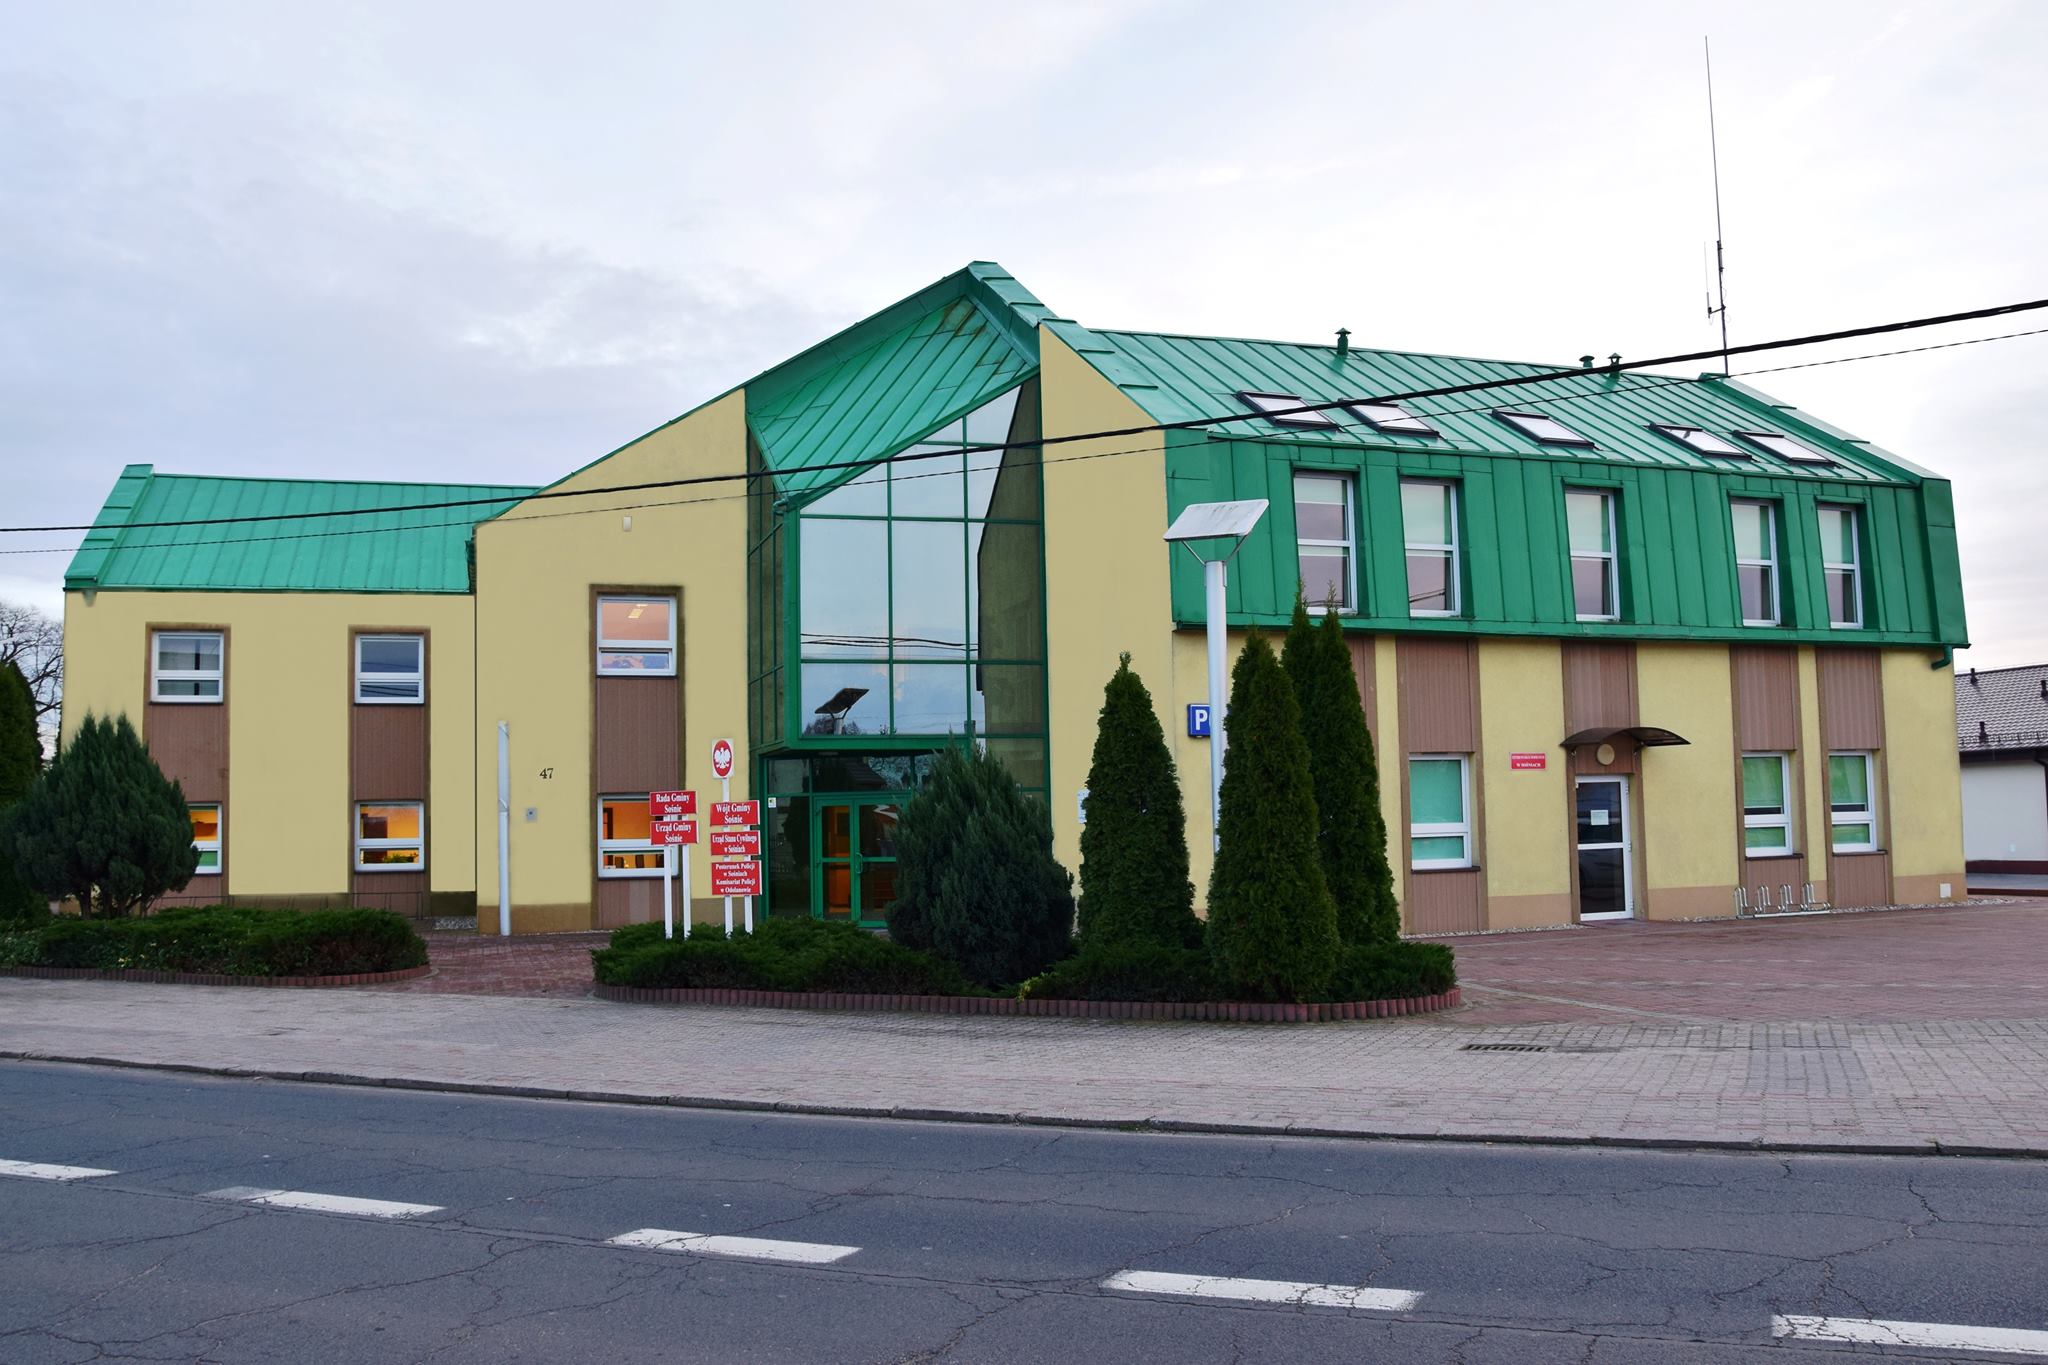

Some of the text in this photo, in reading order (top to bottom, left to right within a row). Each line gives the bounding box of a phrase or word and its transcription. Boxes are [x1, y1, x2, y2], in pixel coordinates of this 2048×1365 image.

[1195, 709, 1208, 730] P
[539, 767, 554, 779] 47
[656, 792, 689, 804] Rada Gminy
[664, 804, 682, 813] Sośnie
[716, 802, 751, 814] Wójt Gminy
[724, 814, 743, 824] Sośnie
[655, 822, 691, 834] Urząd Gminy
[665, 834, 683, 843] Sośnie
[712, 833, 757, 844] Urząd Stanu Cywilnego
[728, 844, 745, 853] Sośniach
[740, 862, 755, 871] Policji
[741, 878, 755, 886] Policji
